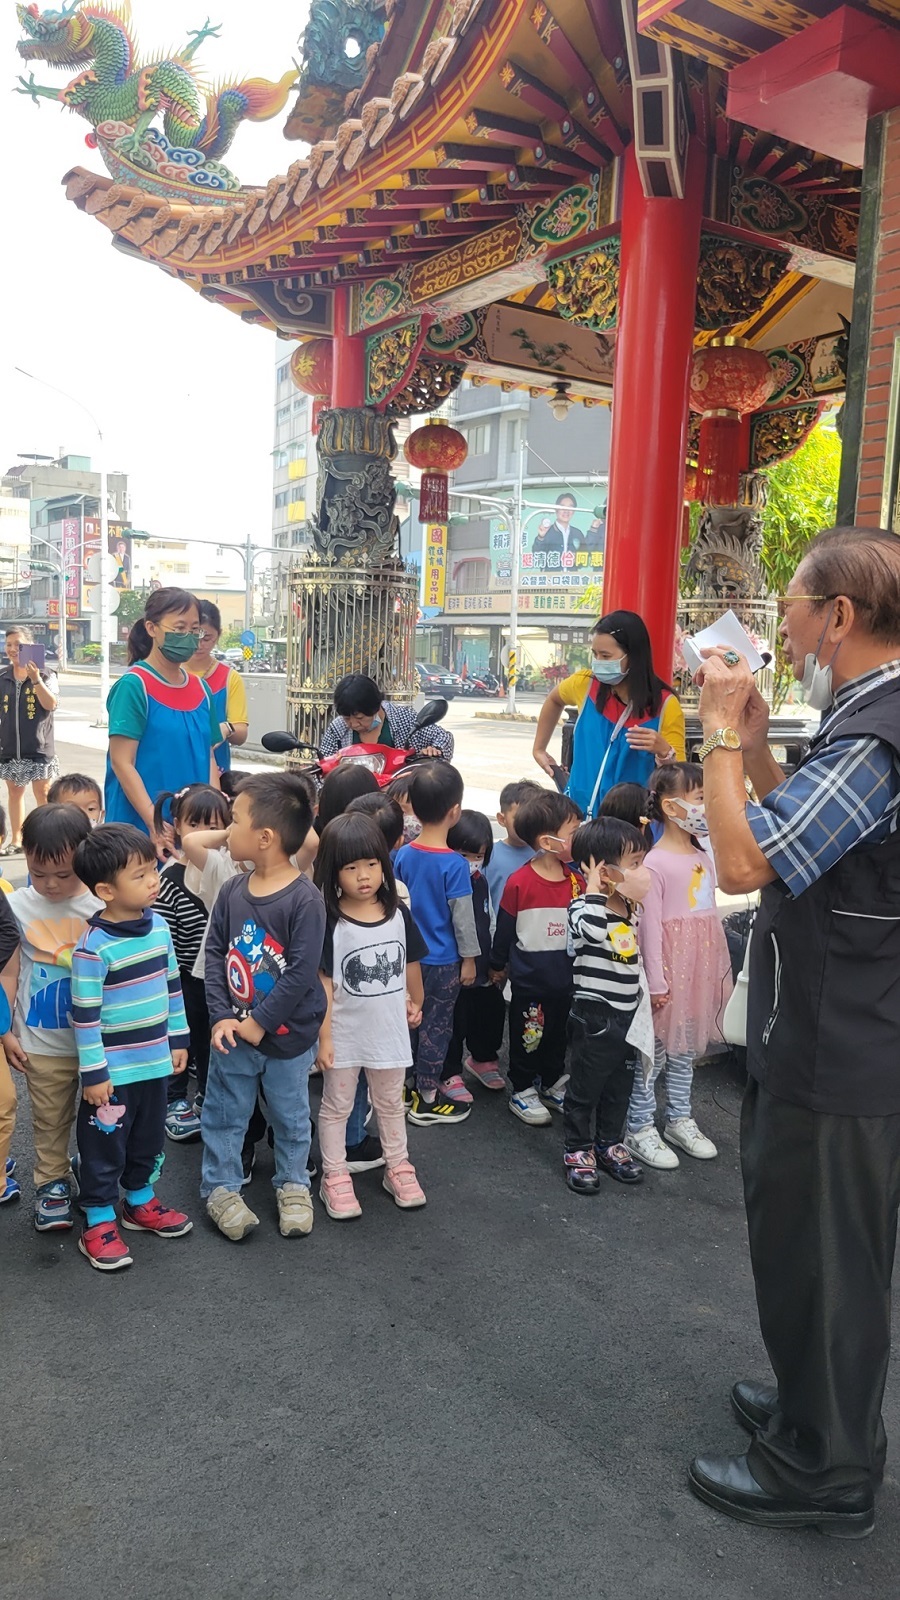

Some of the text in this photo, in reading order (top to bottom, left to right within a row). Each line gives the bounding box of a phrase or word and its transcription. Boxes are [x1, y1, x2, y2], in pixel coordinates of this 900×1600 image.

[429, 568, 439, 604] 用品社
[547, 927, 565, 936] Lee
